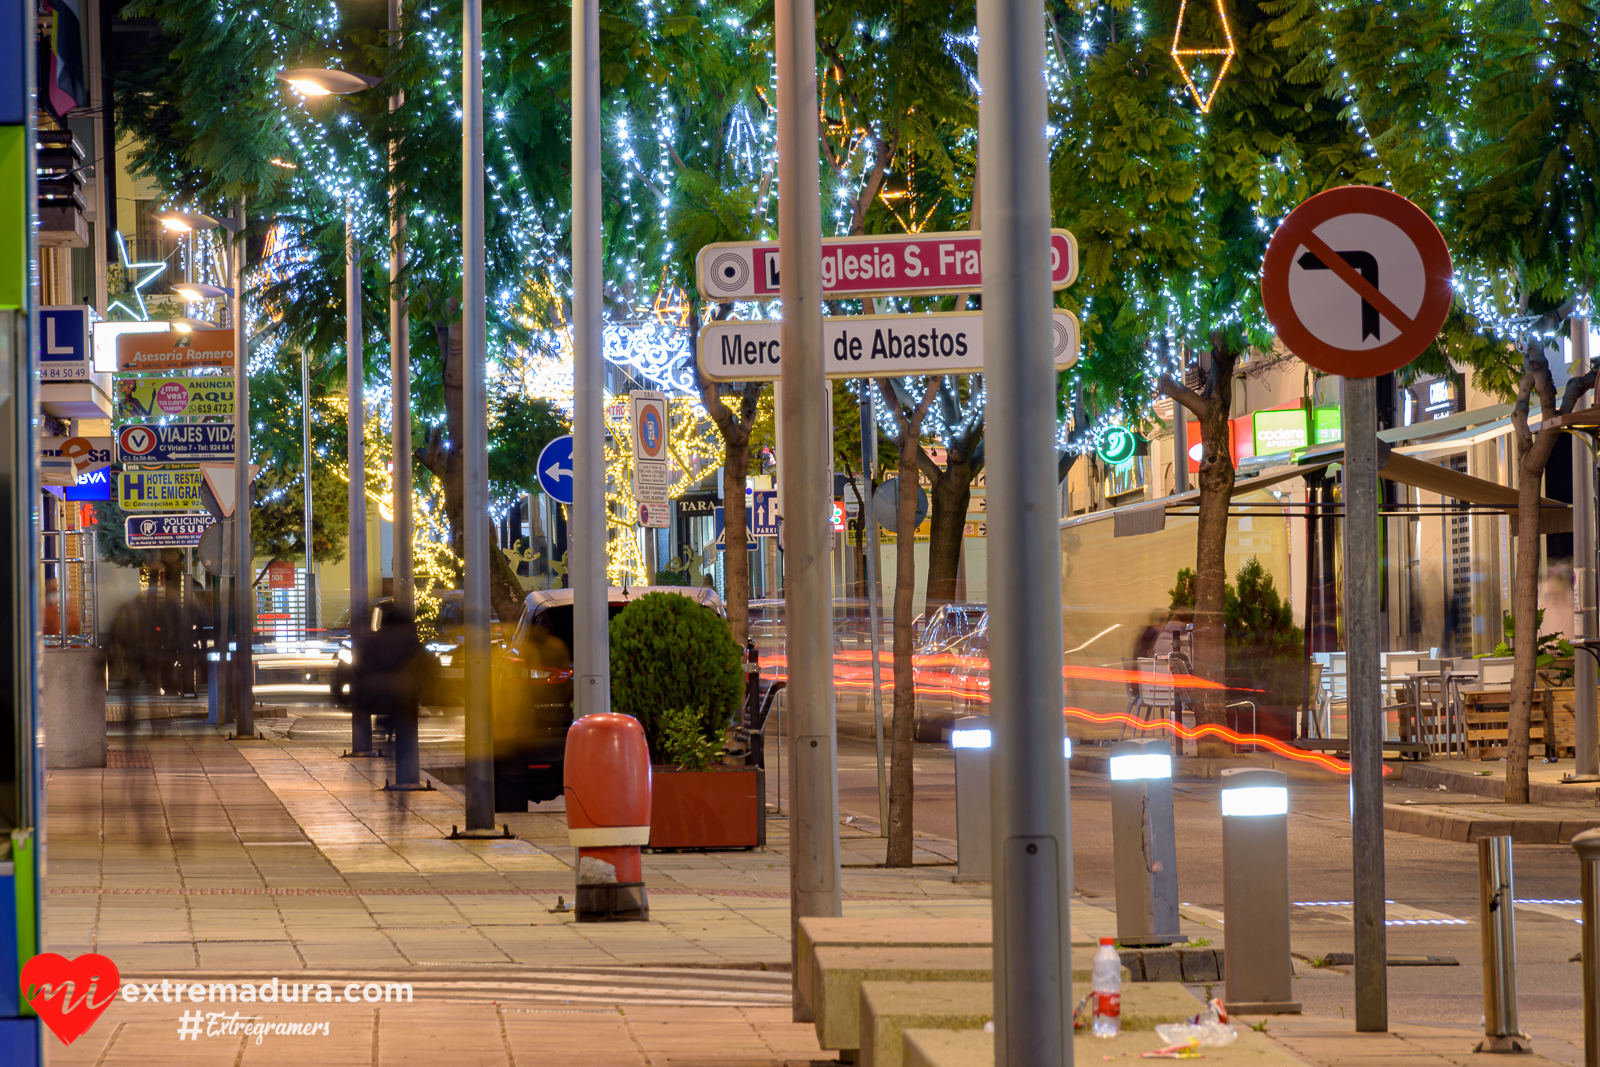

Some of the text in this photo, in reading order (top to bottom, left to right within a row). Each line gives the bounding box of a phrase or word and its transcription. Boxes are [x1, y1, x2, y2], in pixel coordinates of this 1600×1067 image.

[822, 247, 895, 288] glesia
[904, 245, 929, 278] S.
[47, 317, 74, 354] L
[721, 328, 968, 365] Merc de Abastos
[133, 349, 234, 362] Asesoría Romero
[50, 369, 60, 377] 84
[63, 369, 73, 377] 50
[75, 369, 85, 377] 49
[189, 380, 235, 389] ANÚNCIAT
[166, 391, 187, 400] ves?
[191, 392, 234, 402] AQU
[198, 404, 212, 413] 619
[214, 404, 228, 413] 472
[158, 427, 203, 442] VIAJES
[1257, 427, 1305, 440] codere
[1266, 439, 1305, 448] APUESTAS
[146, 474, 173, 485] HOTEL
[124, 474, 145, 500] H
[147, 485, 201, 500] EL EMIGRA
[680, 501, 715, 511] TARA
[164, 516, 217, 526] POLICLINICA
[162, 525, 210, 534] VESUB
